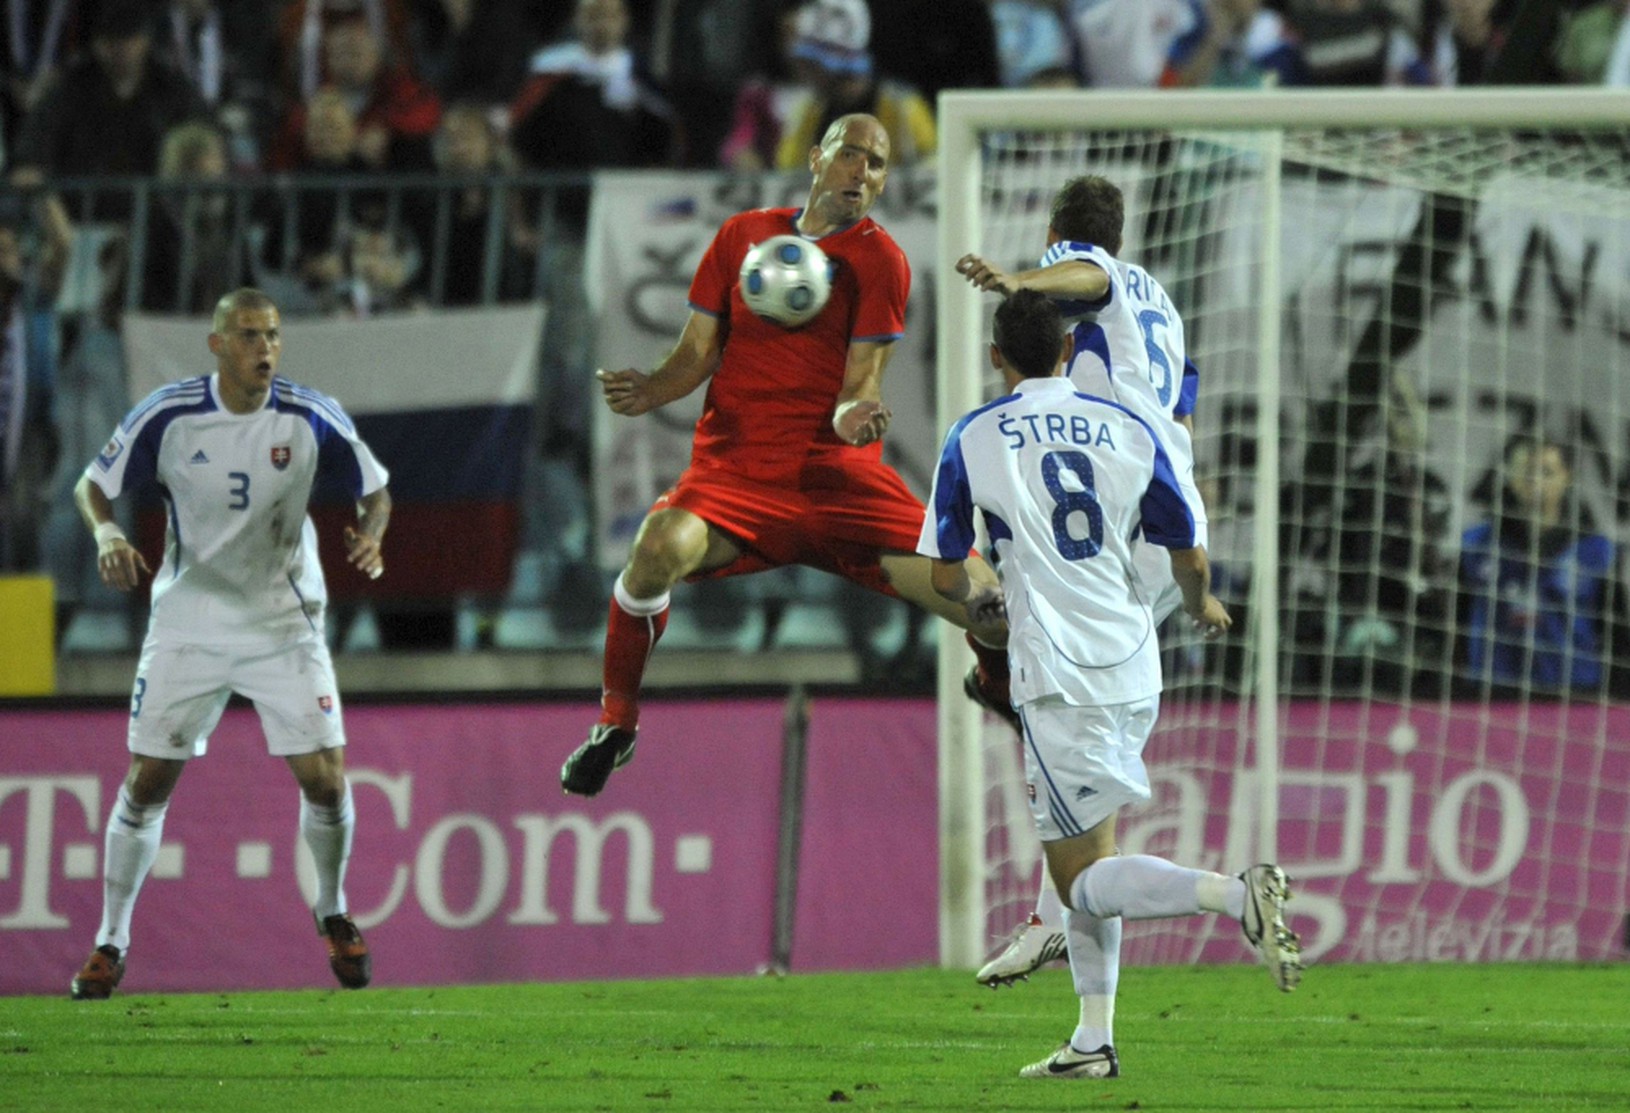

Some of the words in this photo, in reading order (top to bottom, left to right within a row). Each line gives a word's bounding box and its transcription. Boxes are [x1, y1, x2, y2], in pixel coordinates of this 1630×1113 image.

[1139, 309, 1172, 408] 6
[998, 412, 1116, 451] ŠTRBA
[228, 472, 250, 511] 3
[1041, 451, 1104, 561] 8
[131, 677, 147, 719] 3
